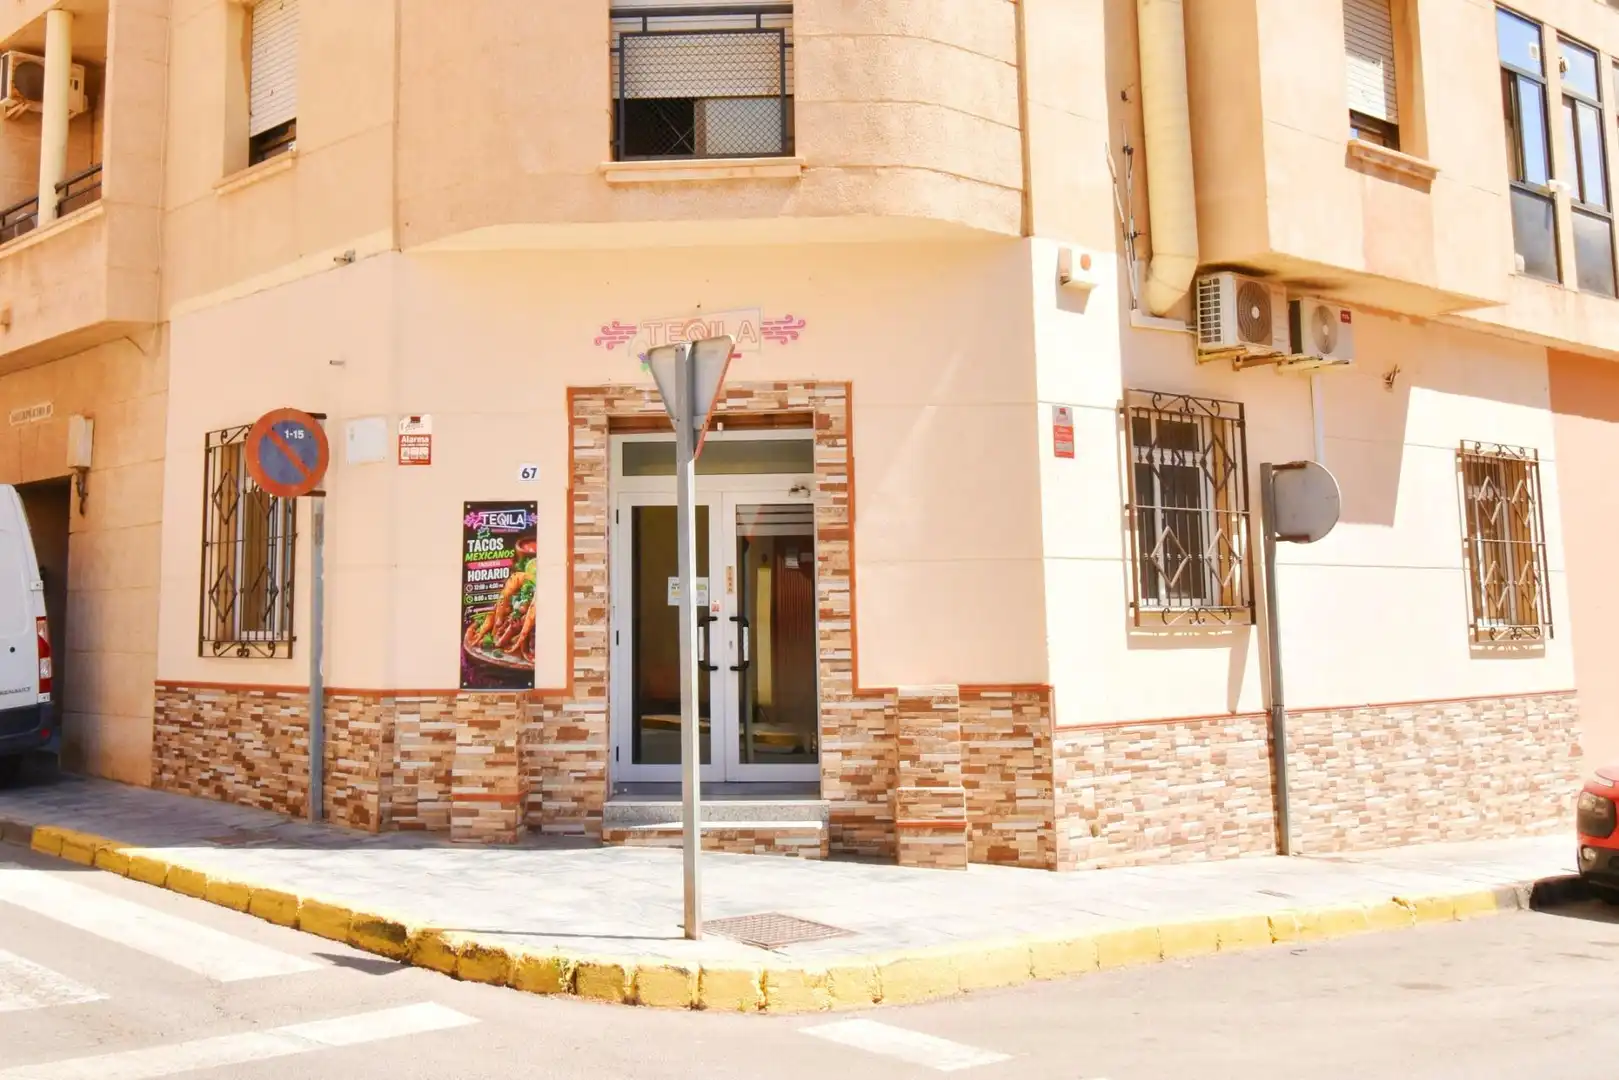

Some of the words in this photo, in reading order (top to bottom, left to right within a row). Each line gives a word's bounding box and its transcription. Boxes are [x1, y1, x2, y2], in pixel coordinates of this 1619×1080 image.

[284, 429, 304, 439] 1-15
[401, 435, 429, 443] Alarma
[521, 467, 538, 479] 67
[481, 513, 525, 526] TEQILA
[467, 538, 504, 553] TACOS
[465, 549, 515, 562] MEXICANOS
[467, 567, 510, 582] HORARIO
